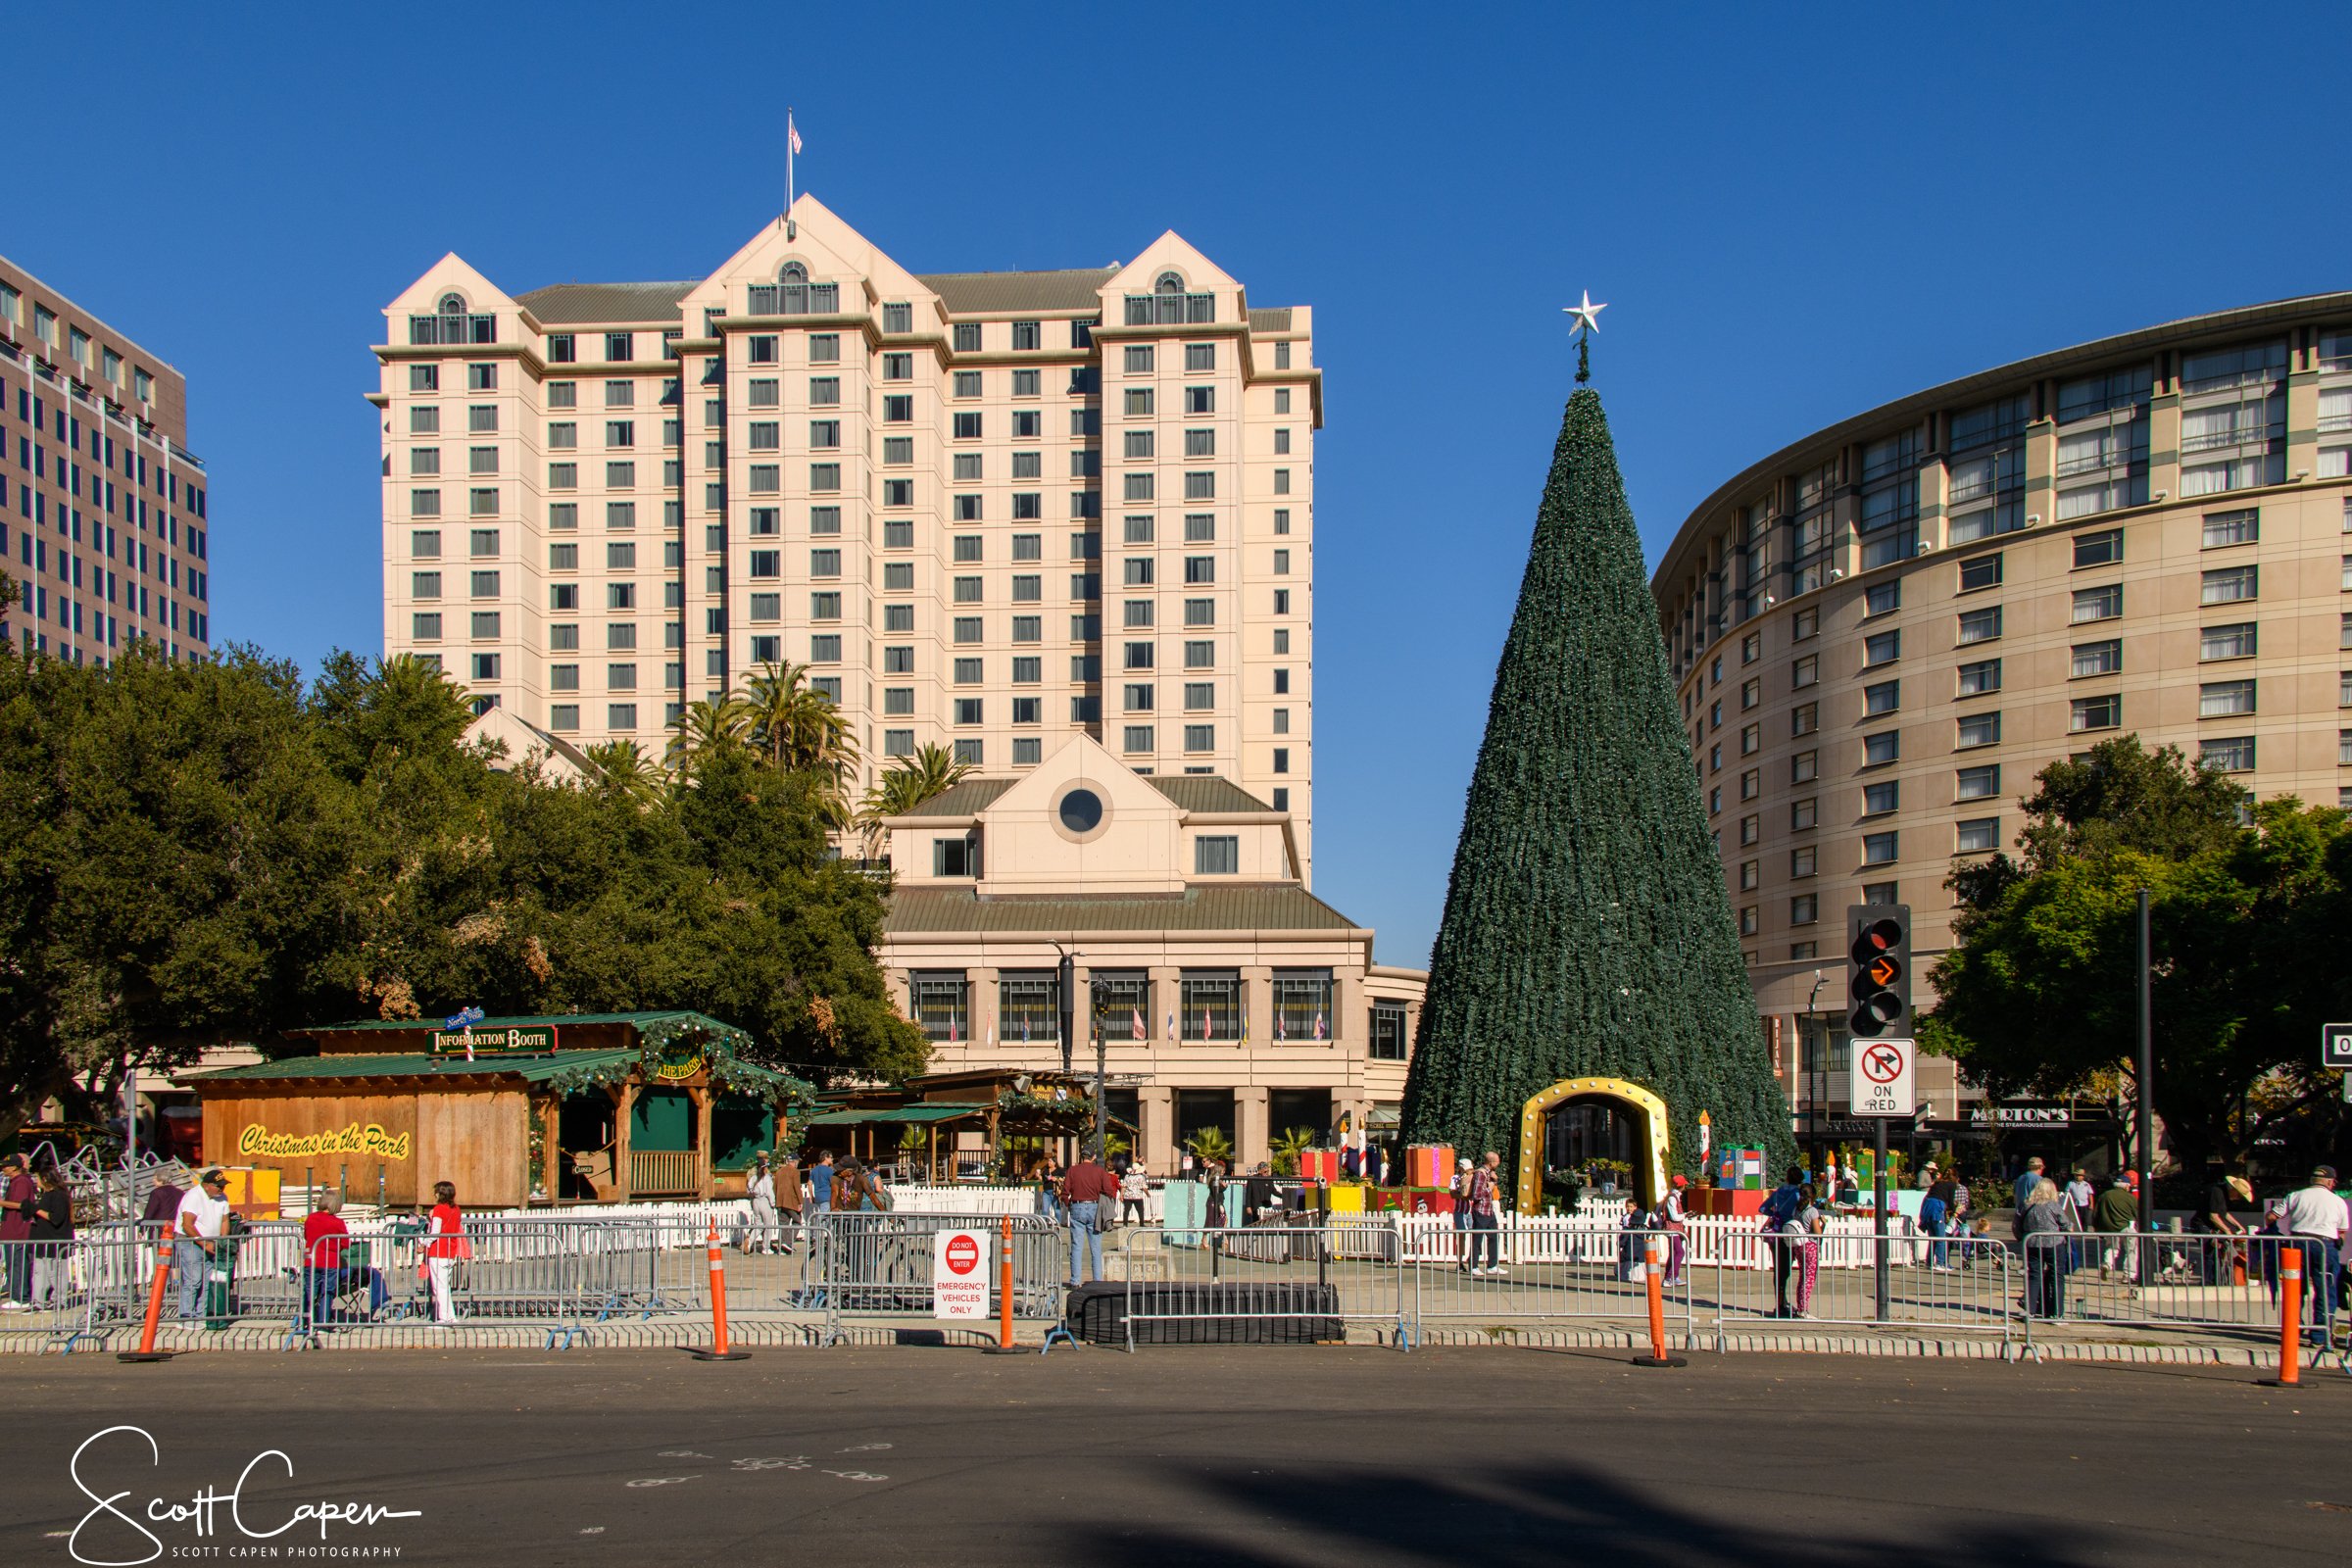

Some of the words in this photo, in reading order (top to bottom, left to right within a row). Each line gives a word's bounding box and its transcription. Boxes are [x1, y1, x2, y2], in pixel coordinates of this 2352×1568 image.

[448, 1014, 466, 1027] North
[678, 1054, 700, 1076] PARK
[1874, 1085, 1892, 1098] ON
[1869, 1099, 1896, 1111] RED
[1971, 1107, 2070, 1121] MORTON'S
[241, 1126, 318, 1155] Christmas
[320, 1130, 337, 1152] in
[339, 1125, 362, 1152] the
[365, 1126, 408, 1157] Park
[937, 1282, 986, 1291] EMERGENCY
[942, 1294, 980, 1302] VEHICLES
[950, 1305, 972, 1314] ONLY
